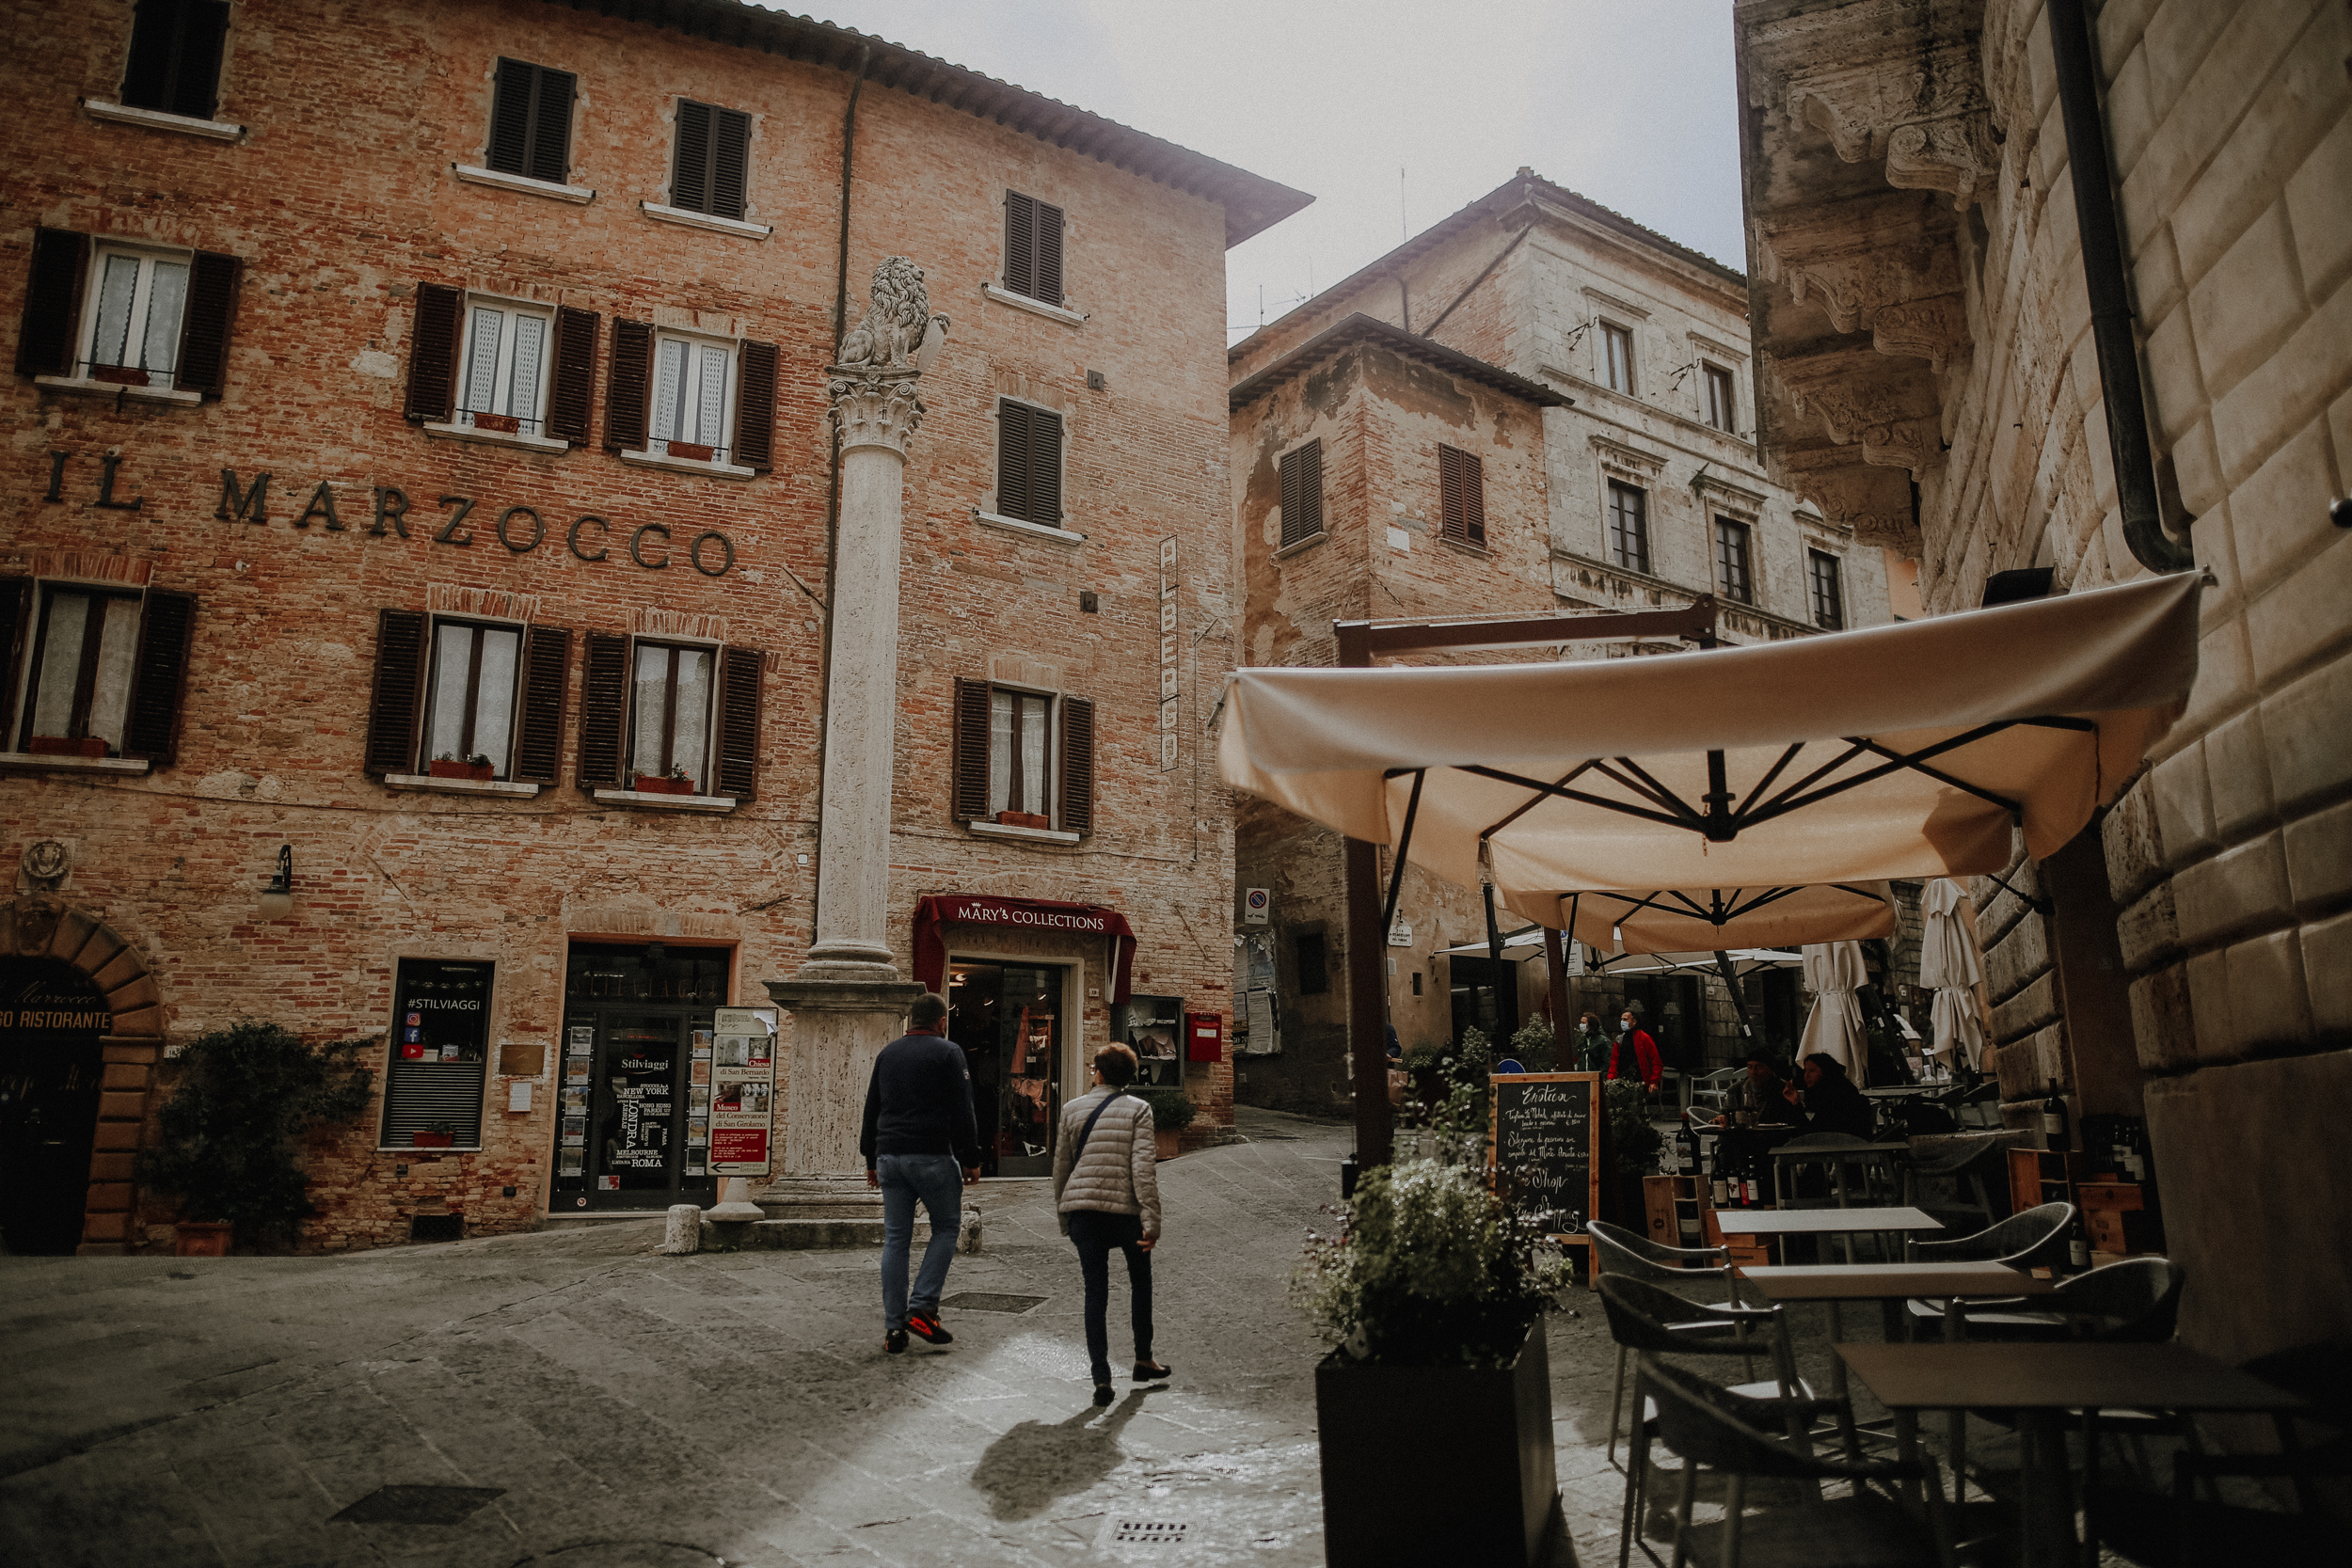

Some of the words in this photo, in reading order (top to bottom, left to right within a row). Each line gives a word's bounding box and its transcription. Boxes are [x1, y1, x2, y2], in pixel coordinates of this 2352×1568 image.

[43, 451, 143, 510] IL
[214, 468, 735, 577] MARZOCCO
[1160, 537, 1178, 769] ALBERGO
[1011, 911, 1104, 930] COLLECTIONS
[407, 998, 480, 1010] #STILVIAGGI
[20, 1010, 111, 1029] RISTORANTE
[621, 1058, 669, 1071] Stilviaggi
[1522, 1084, 1577, 1104] Enoteca
[627, 1099, 640, 1149] LONDRA
[631, 1159, 662, 1167] ROMA
